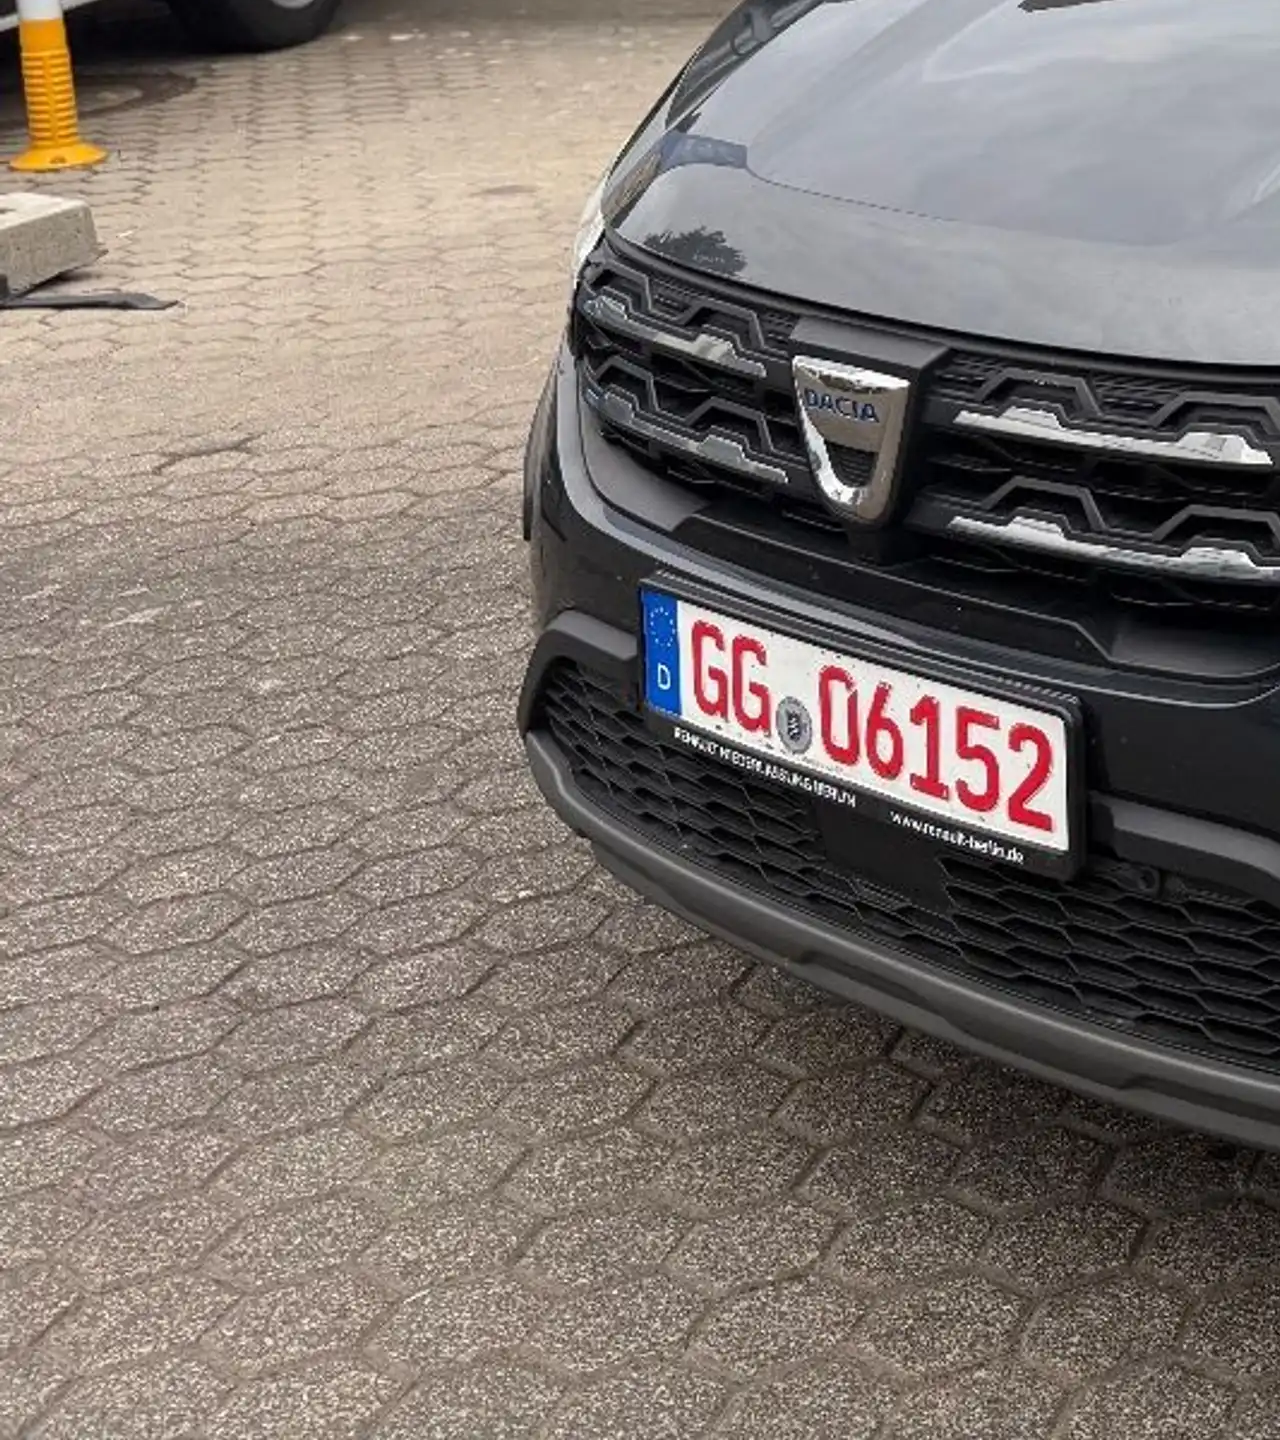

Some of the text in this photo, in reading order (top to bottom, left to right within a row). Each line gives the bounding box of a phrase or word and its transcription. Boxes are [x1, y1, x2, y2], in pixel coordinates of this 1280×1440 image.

[804, 387, 880, 423] DACIA
[657, 662, 671, 691] D
[691, 619, 1054, 833] GG 06152
